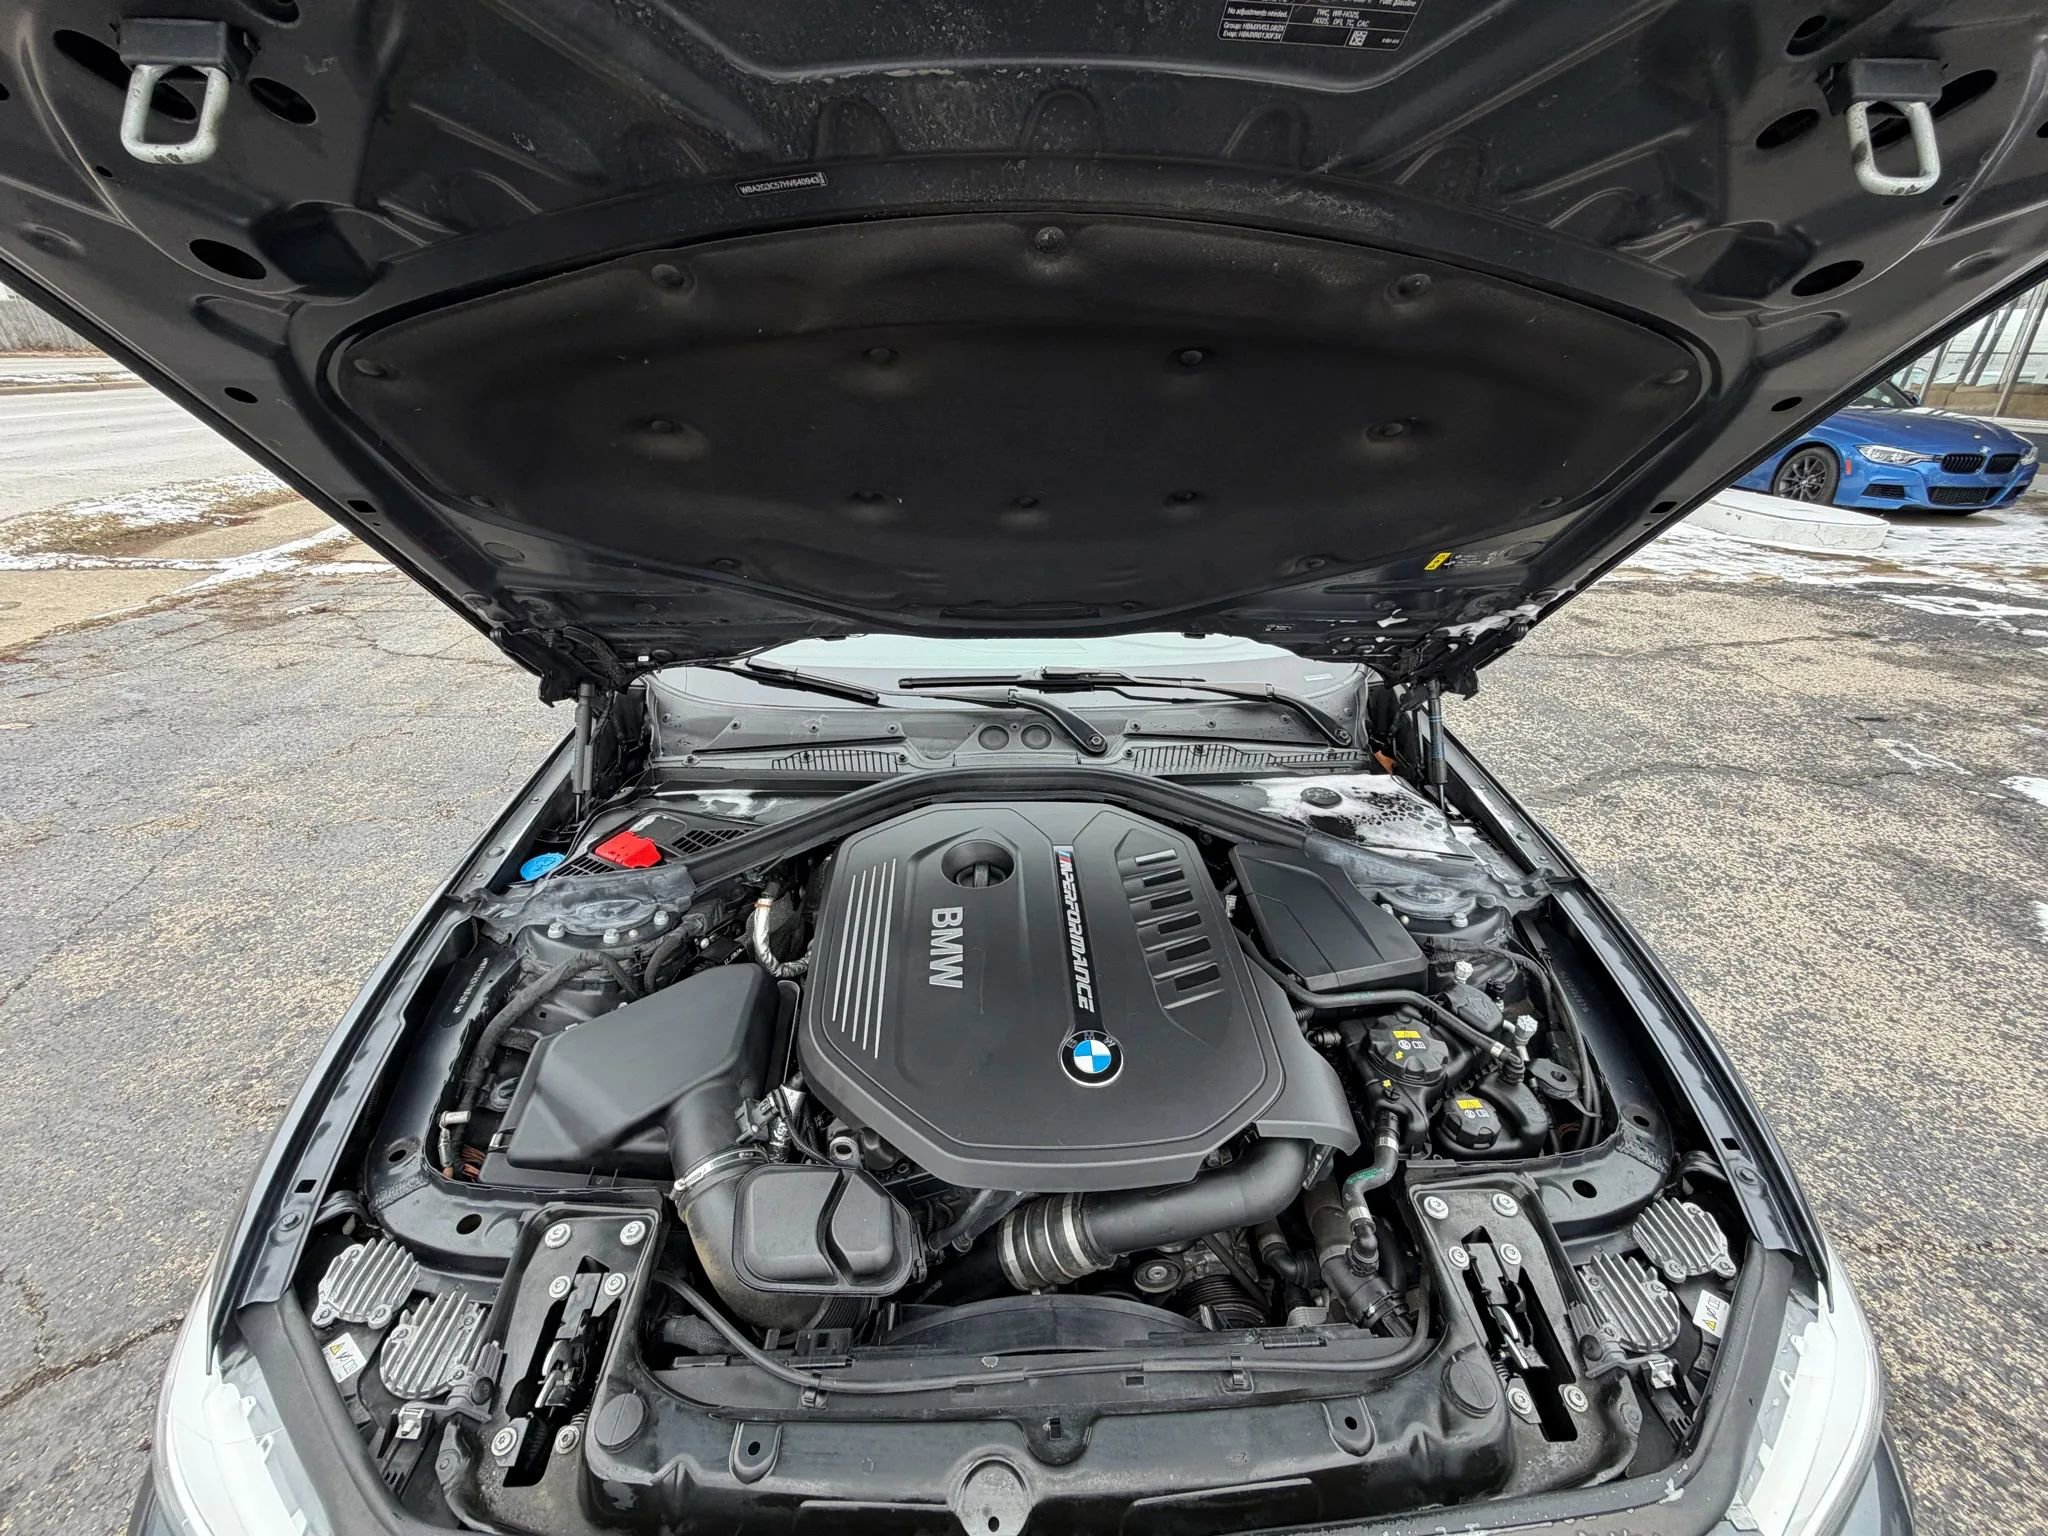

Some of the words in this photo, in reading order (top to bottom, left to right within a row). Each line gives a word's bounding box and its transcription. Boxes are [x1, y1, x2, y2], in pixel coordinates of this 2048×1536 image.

[1227, 7, 1236, 15] No
[1235, 8, 1267, 17] adjustments
[1267, 10, 1288, 18] needed.
[1223, 21, 1242, 30] Group:
[1356, 19, 1370, 28] CAC
[1222, 30, 1238, 38] Evap:
[928, 905, 964, 990] BMW
[1062, 872, 1095, 1013] PERFORMANCE
